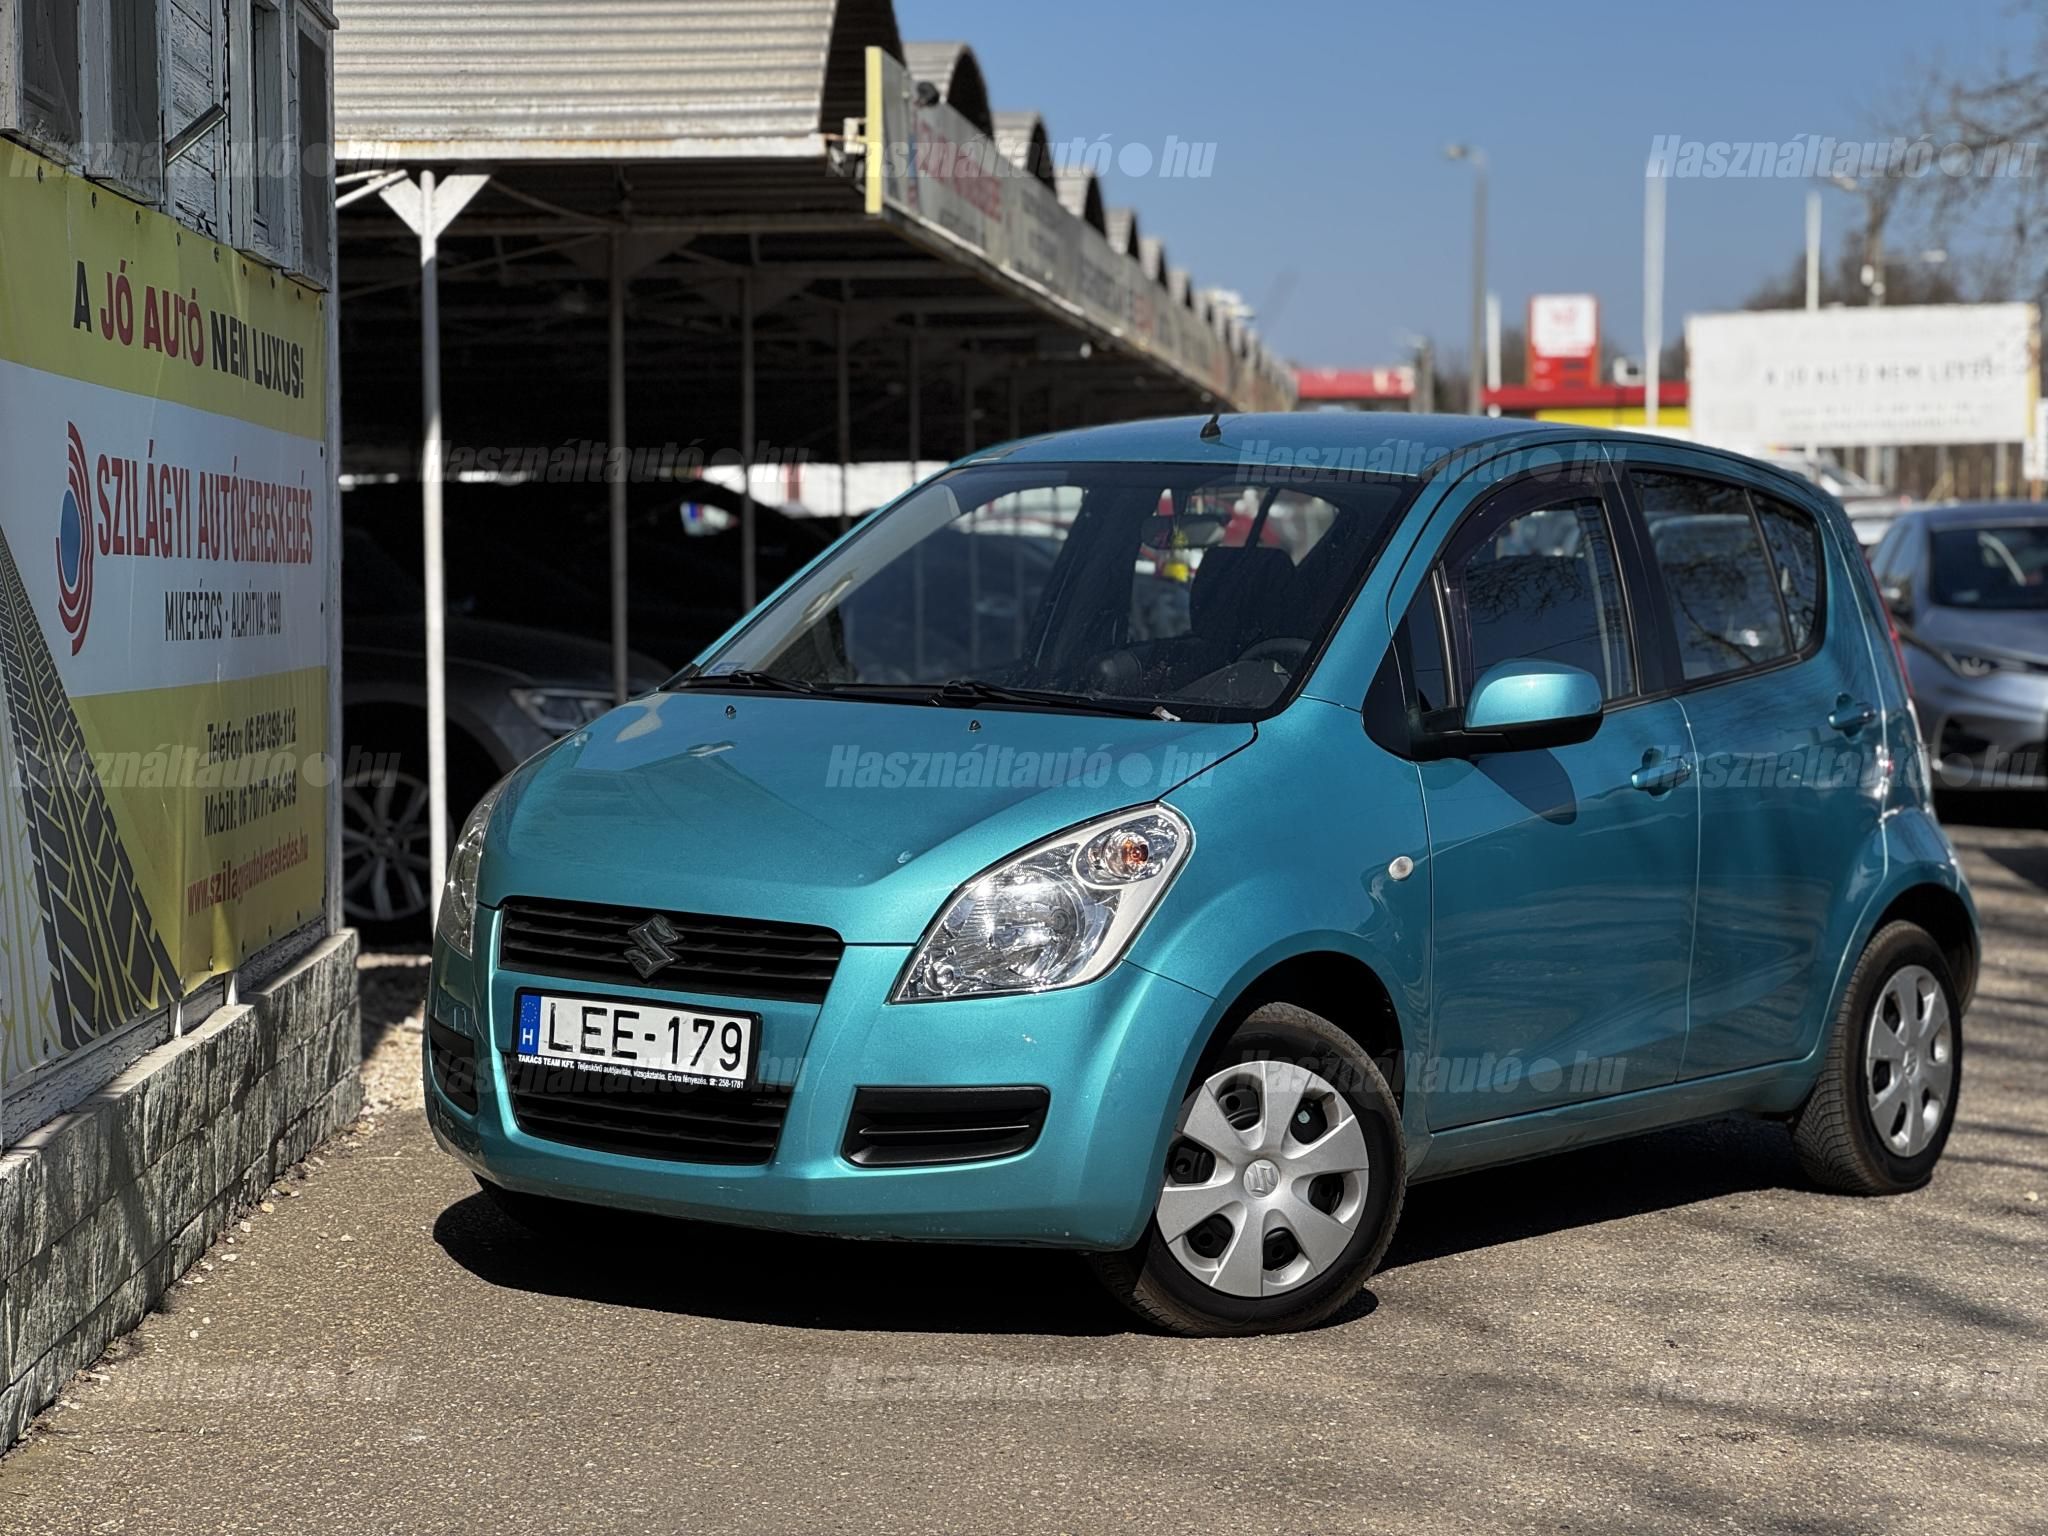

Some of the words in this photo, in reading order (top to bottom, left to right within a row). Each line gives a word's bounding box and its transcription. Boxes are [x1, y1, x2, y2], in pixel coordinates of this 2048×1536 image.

[73, 260, 92, 333] A
[100, 259, 134, 346] JÓ
[143, 287, 204, 367] AUTÓ
[210, 310, 249, 381] NEM
[252, 328, 304, 399] LUXUS!
[96, 438, 191, 560] SZILÁGYI
[197, 455, 313, 566] AUTÓKERESKEDÉS
[164, 577, 223, 642] MIKEPÉRCS
[267, 590, 282, 635] 1990
[244, 716, 255, 756] 06
[204, 789, 238, 838] Mobil:
[521, 1027, 533, 1046] H
[548, 1002, 743, 1072] LEE-179
[517, 1053, 542, 1066] TAKÁCS
[543, 1056, 561, 1069] TEAM
[561, 1059, 575, 1069] KFT.
[667, 1072, 682, 1082] Extra
[718, 1078, 744, 1089] 258-1781
